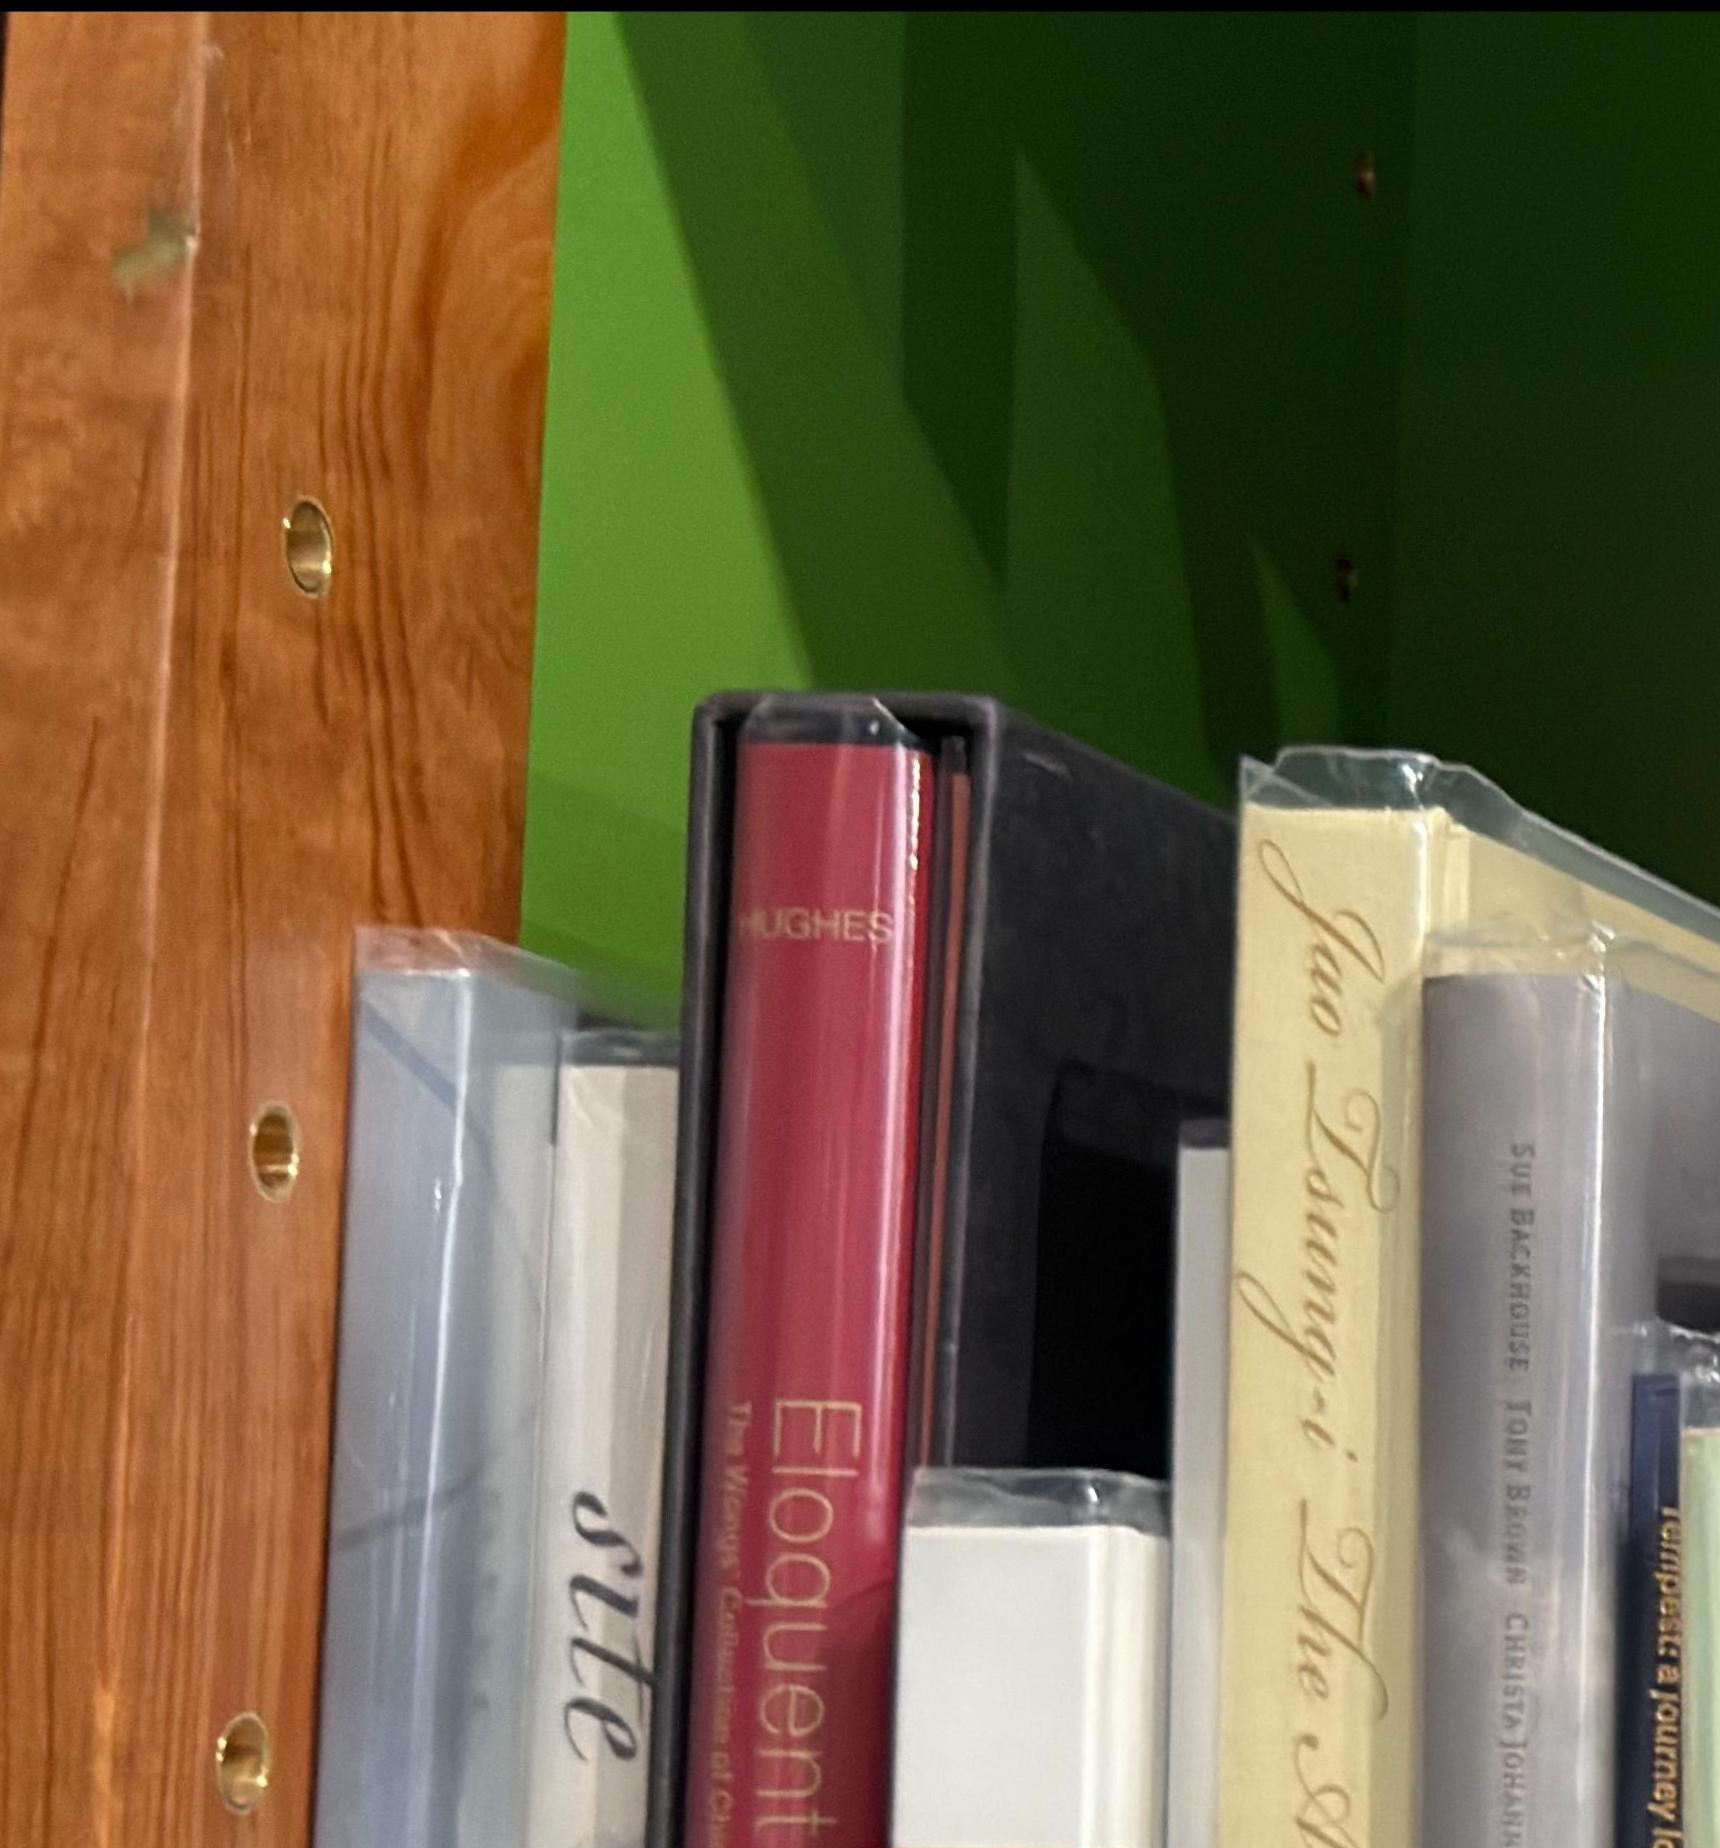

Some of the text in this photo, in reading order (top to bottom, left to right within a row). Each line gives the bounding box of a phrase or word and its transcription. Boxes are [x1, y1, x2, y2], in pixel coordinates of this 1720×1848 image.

[1258, 842, 1387, 1040] Jao
[1237, 1062, 1399, 1460] Tsung-i
[569, 1488, 653, 1765] site
[757, 1398, 865, 1838] Eloquent
